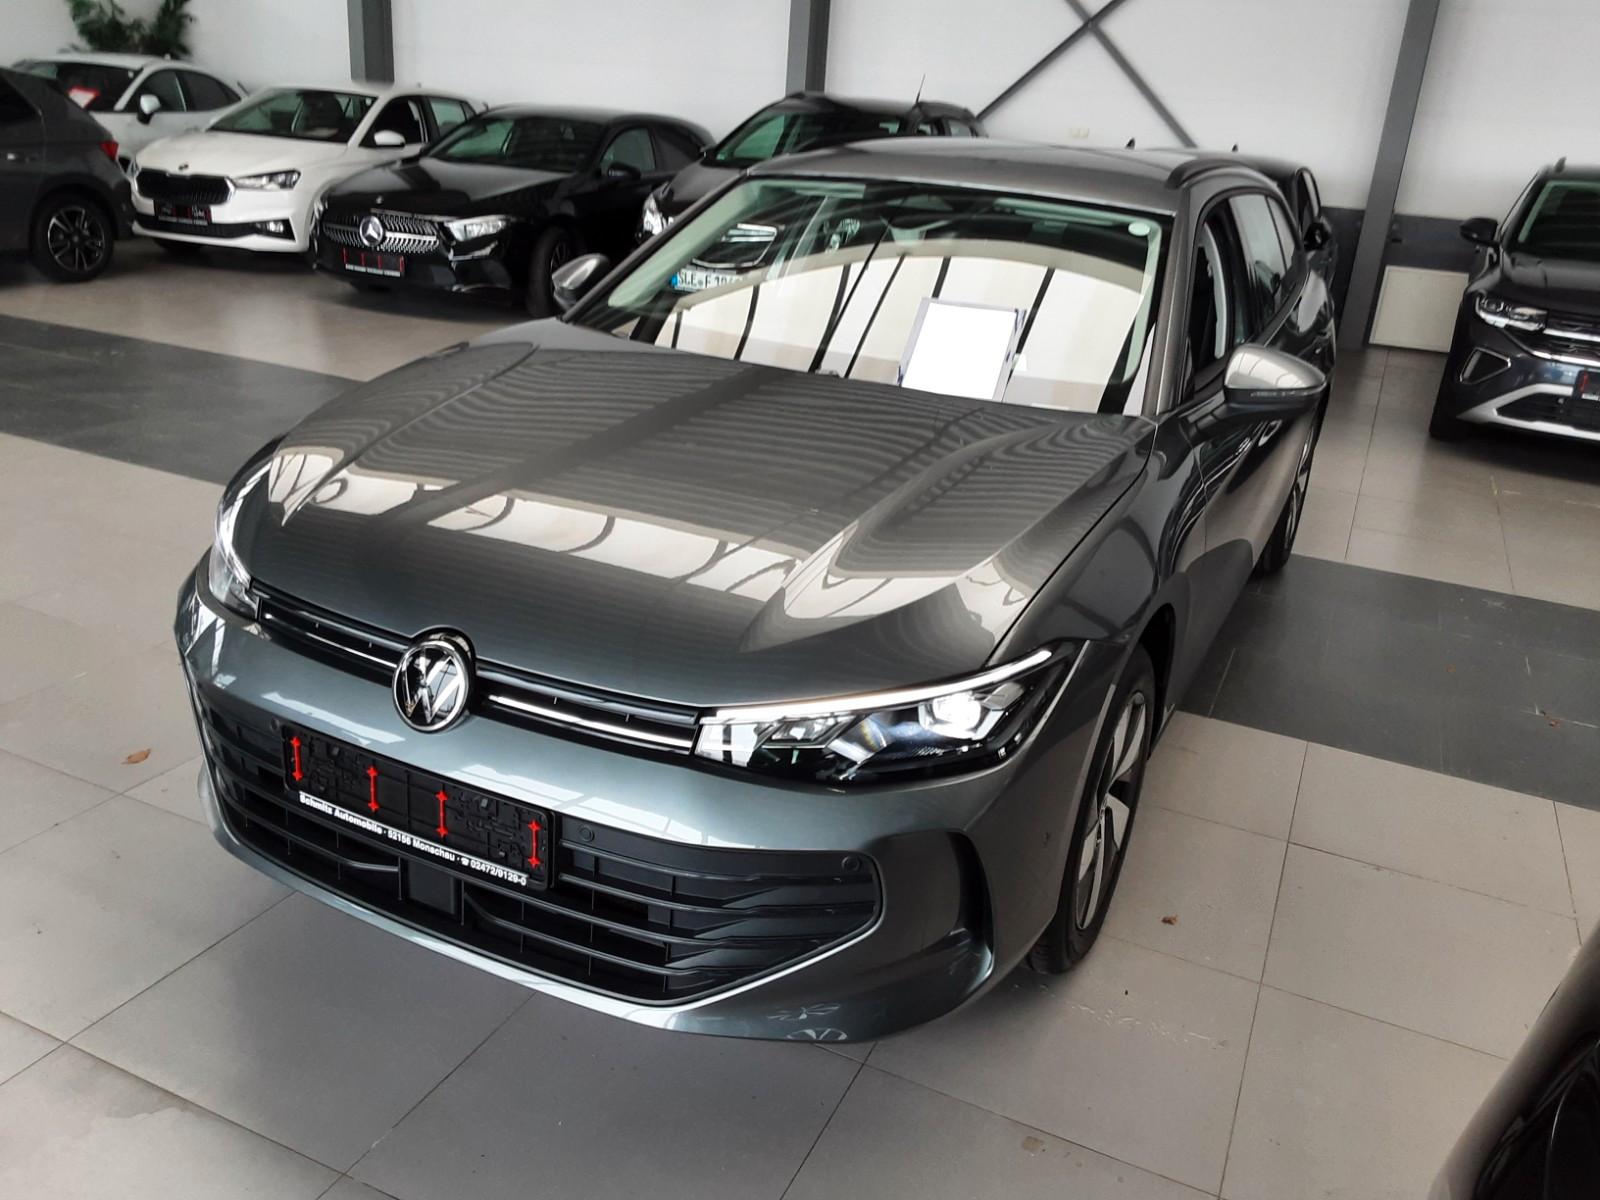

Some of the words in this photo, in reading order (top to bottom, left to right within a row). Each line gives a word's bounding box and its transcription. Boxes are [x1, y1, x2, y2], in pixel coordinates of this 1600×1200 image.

[299, 793, 333, 815] Schmitz
[334, 808, 383, 835] Automobile
[412, 838, 456, 862] Monschau
